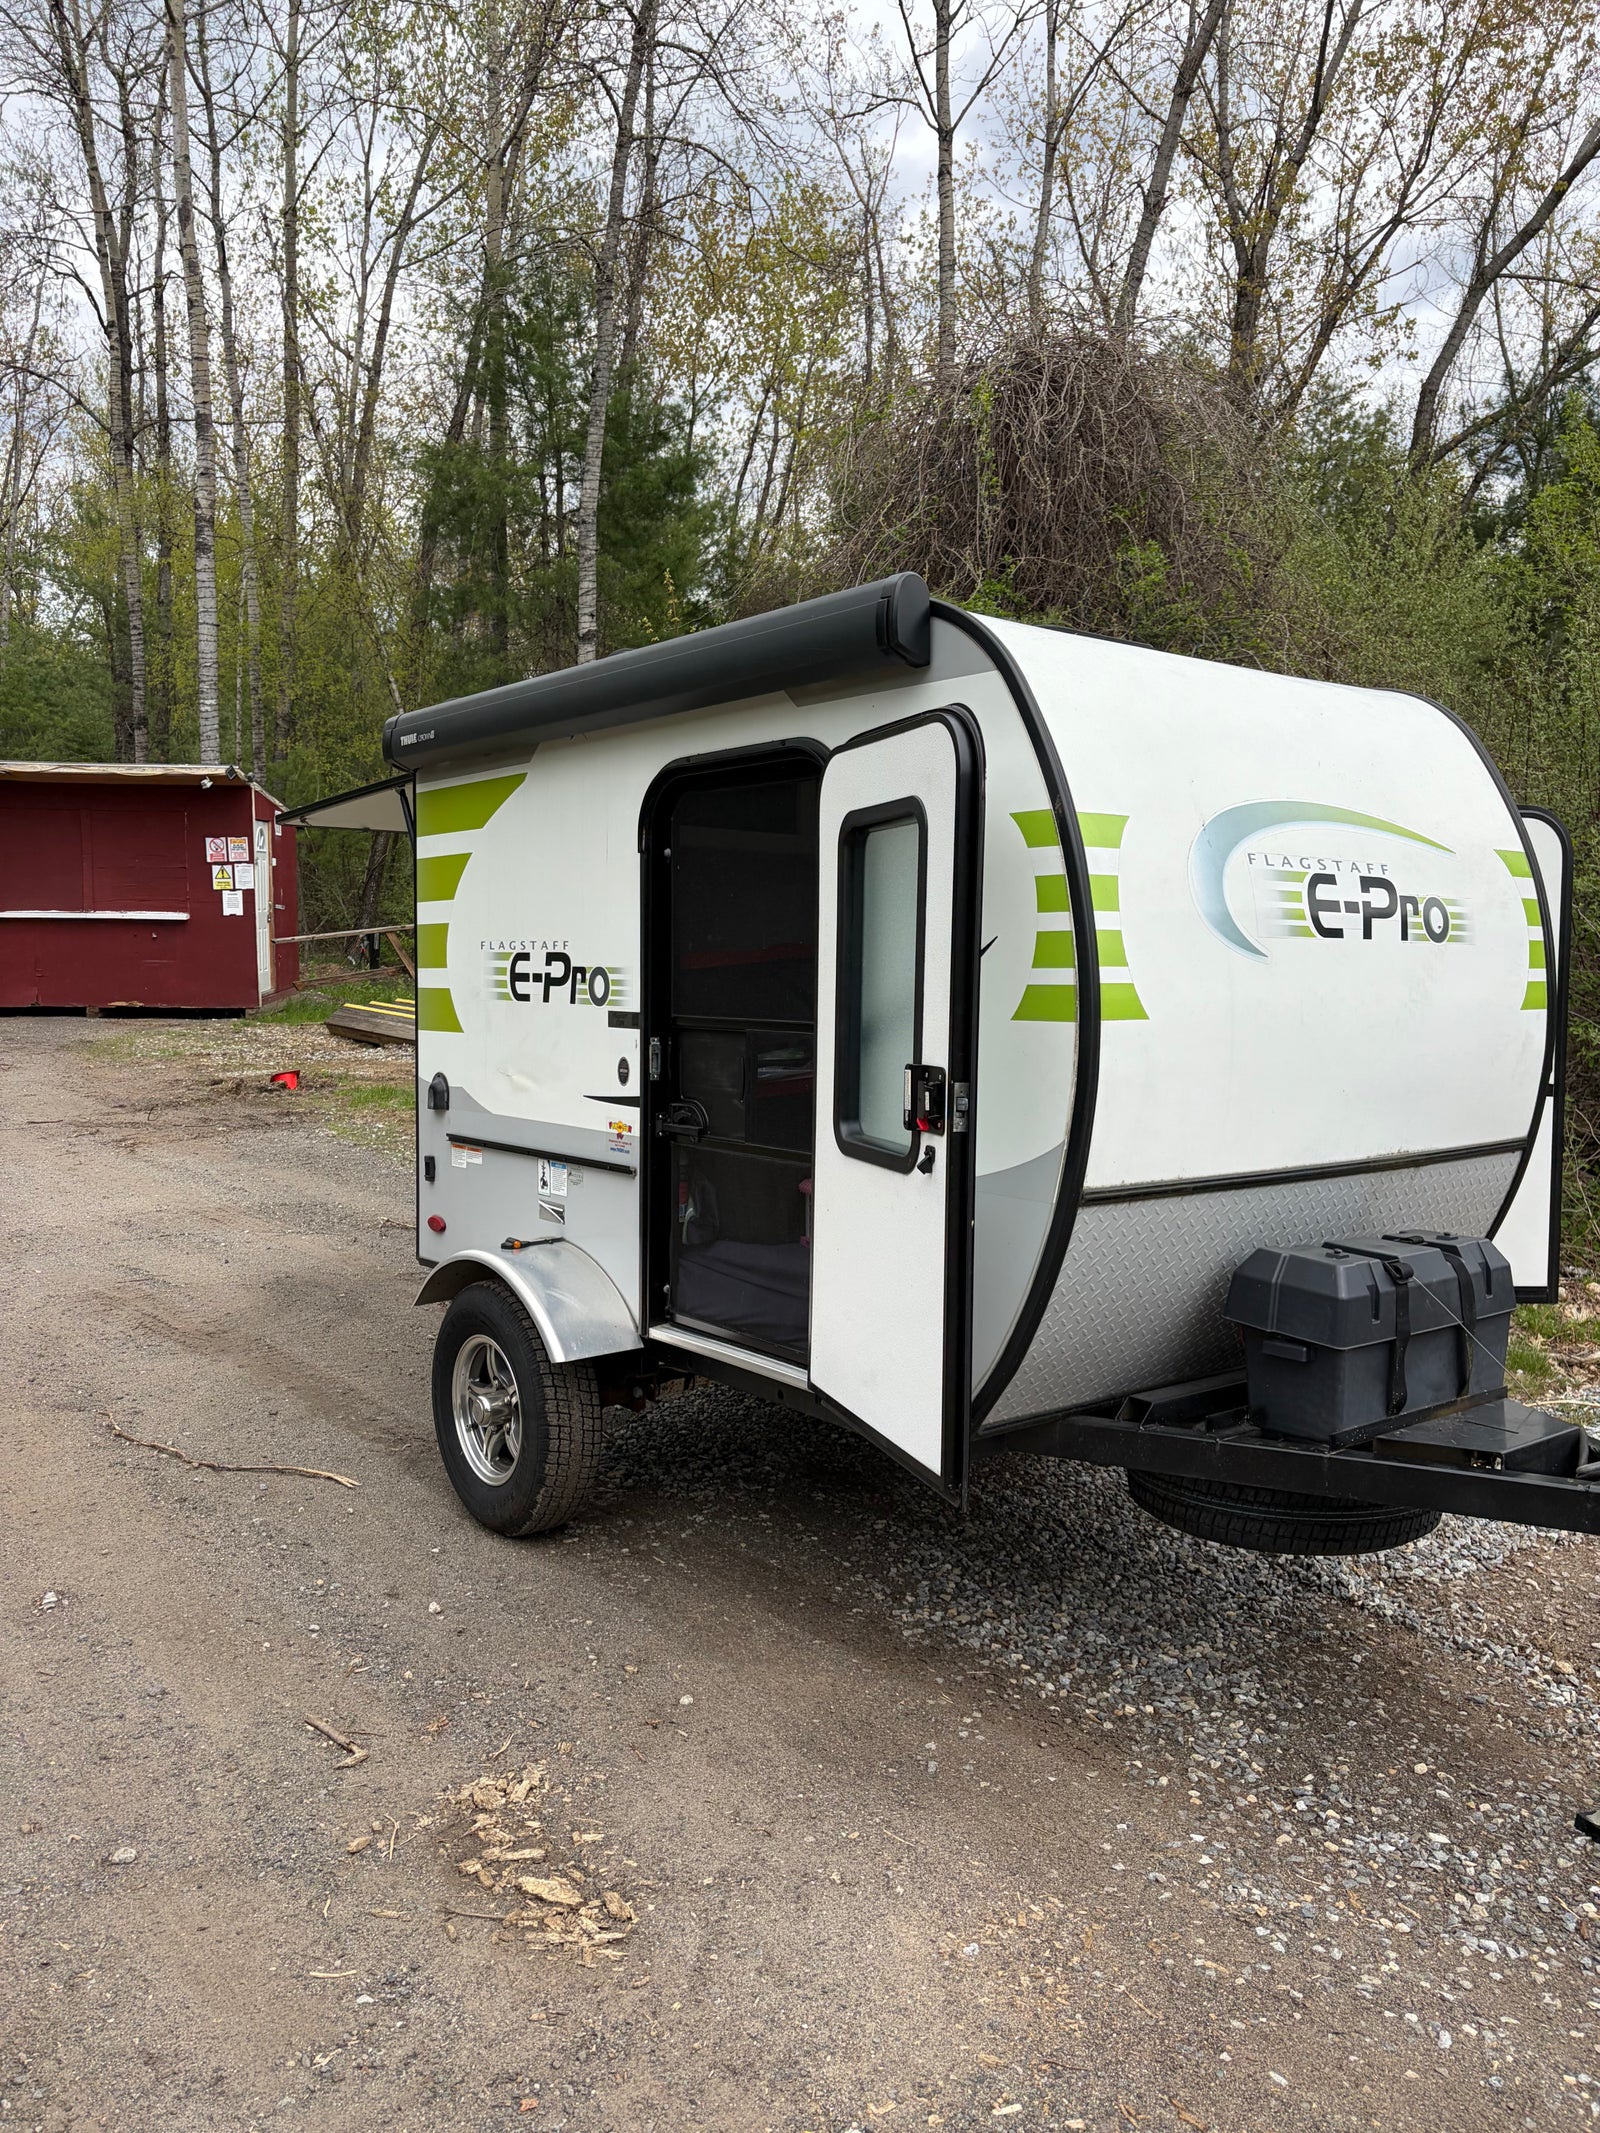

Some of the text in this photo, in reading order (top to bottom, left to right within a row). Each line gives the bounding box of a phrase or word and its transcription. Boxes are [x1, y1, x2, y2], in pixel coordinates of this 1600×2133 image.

[400, 733, 417, 746] THULE
[1247, 853, 1390, 875] FLAGSTAFF
[1307, 872, 1451, 943] E-Pro
[480, 940, 569, 950] FLAGSTAFF
[510, 952, 610, 1006] E-Pro
